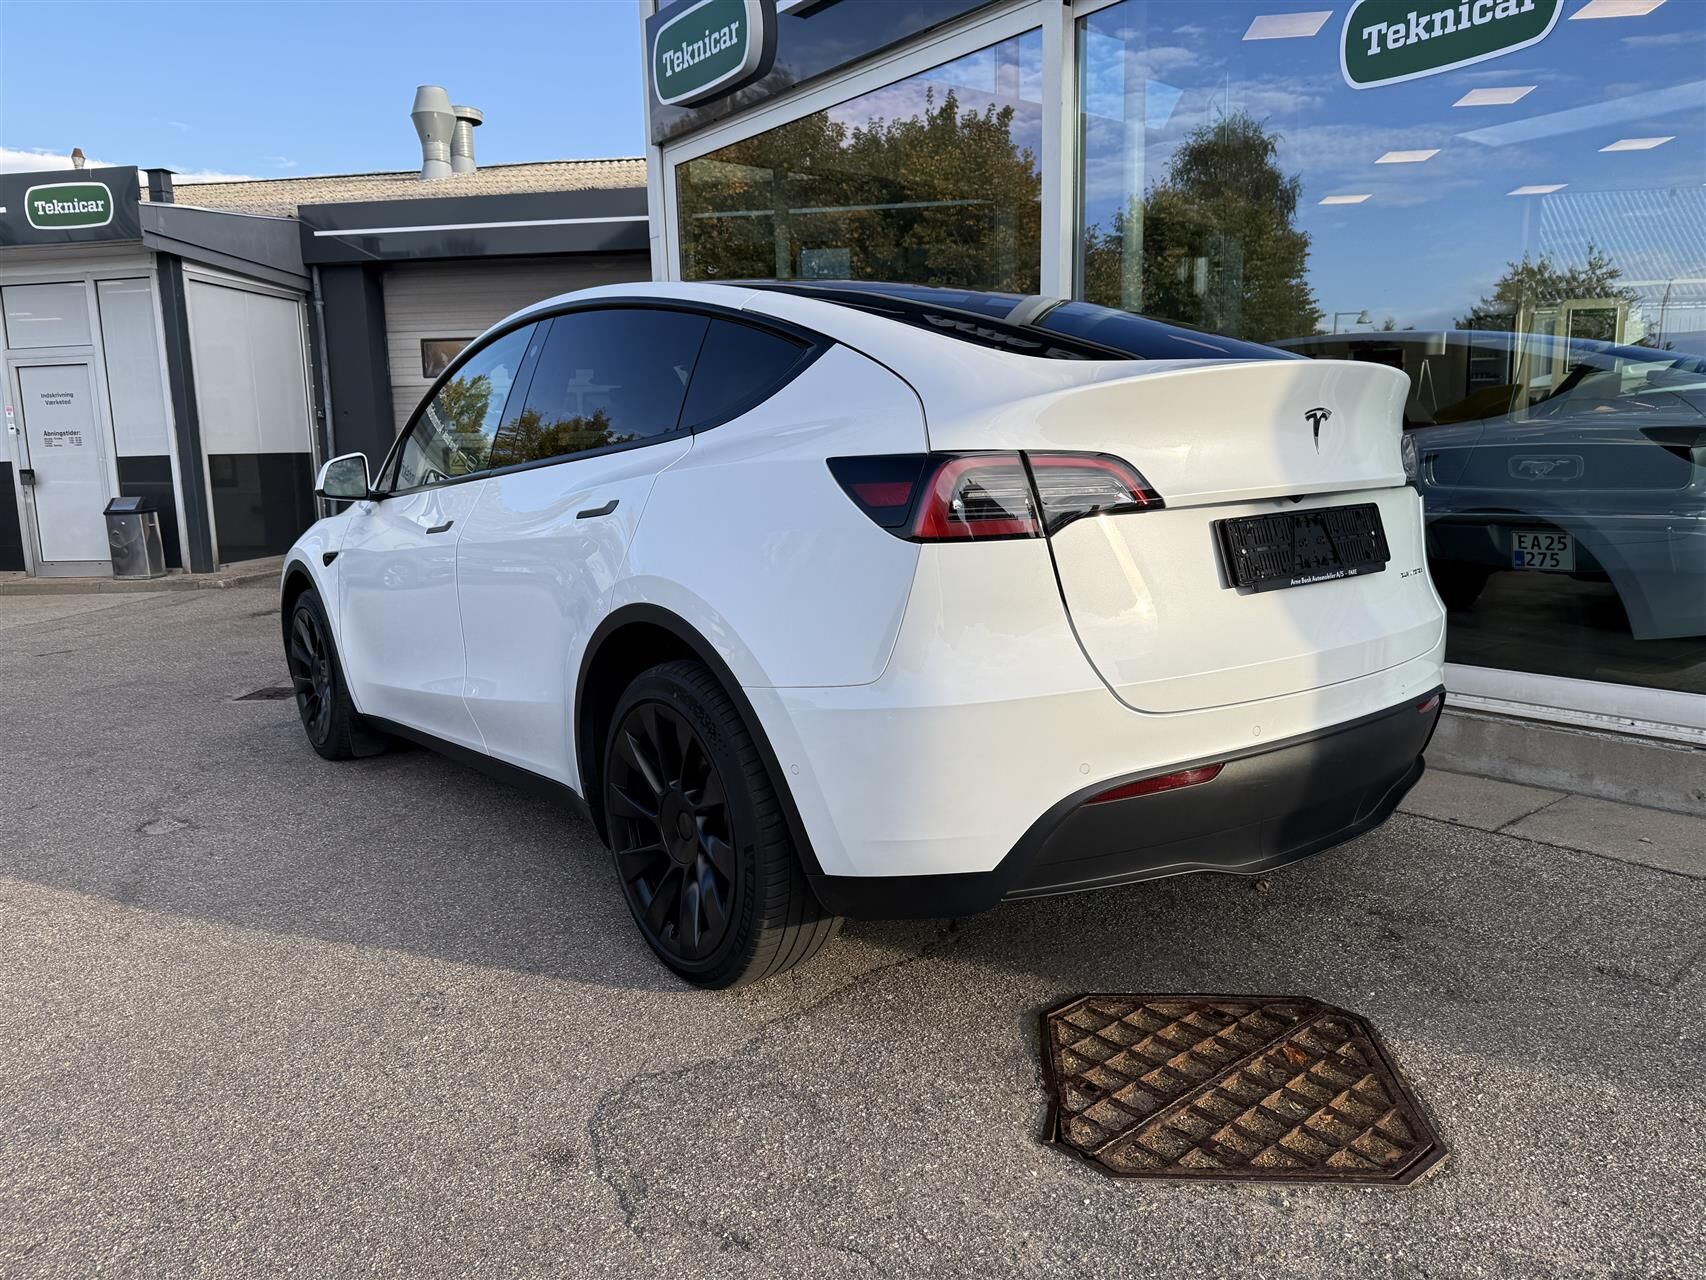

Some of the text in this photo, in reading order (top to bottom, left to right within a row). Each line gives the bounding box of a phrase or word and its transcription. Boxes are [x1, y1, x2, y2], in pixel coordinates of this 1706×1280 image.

[662, 20, 740, 78] Teknicar
[34, 198, 104, 215] Teknicar
[1526, 552, 1560, 568] 275
